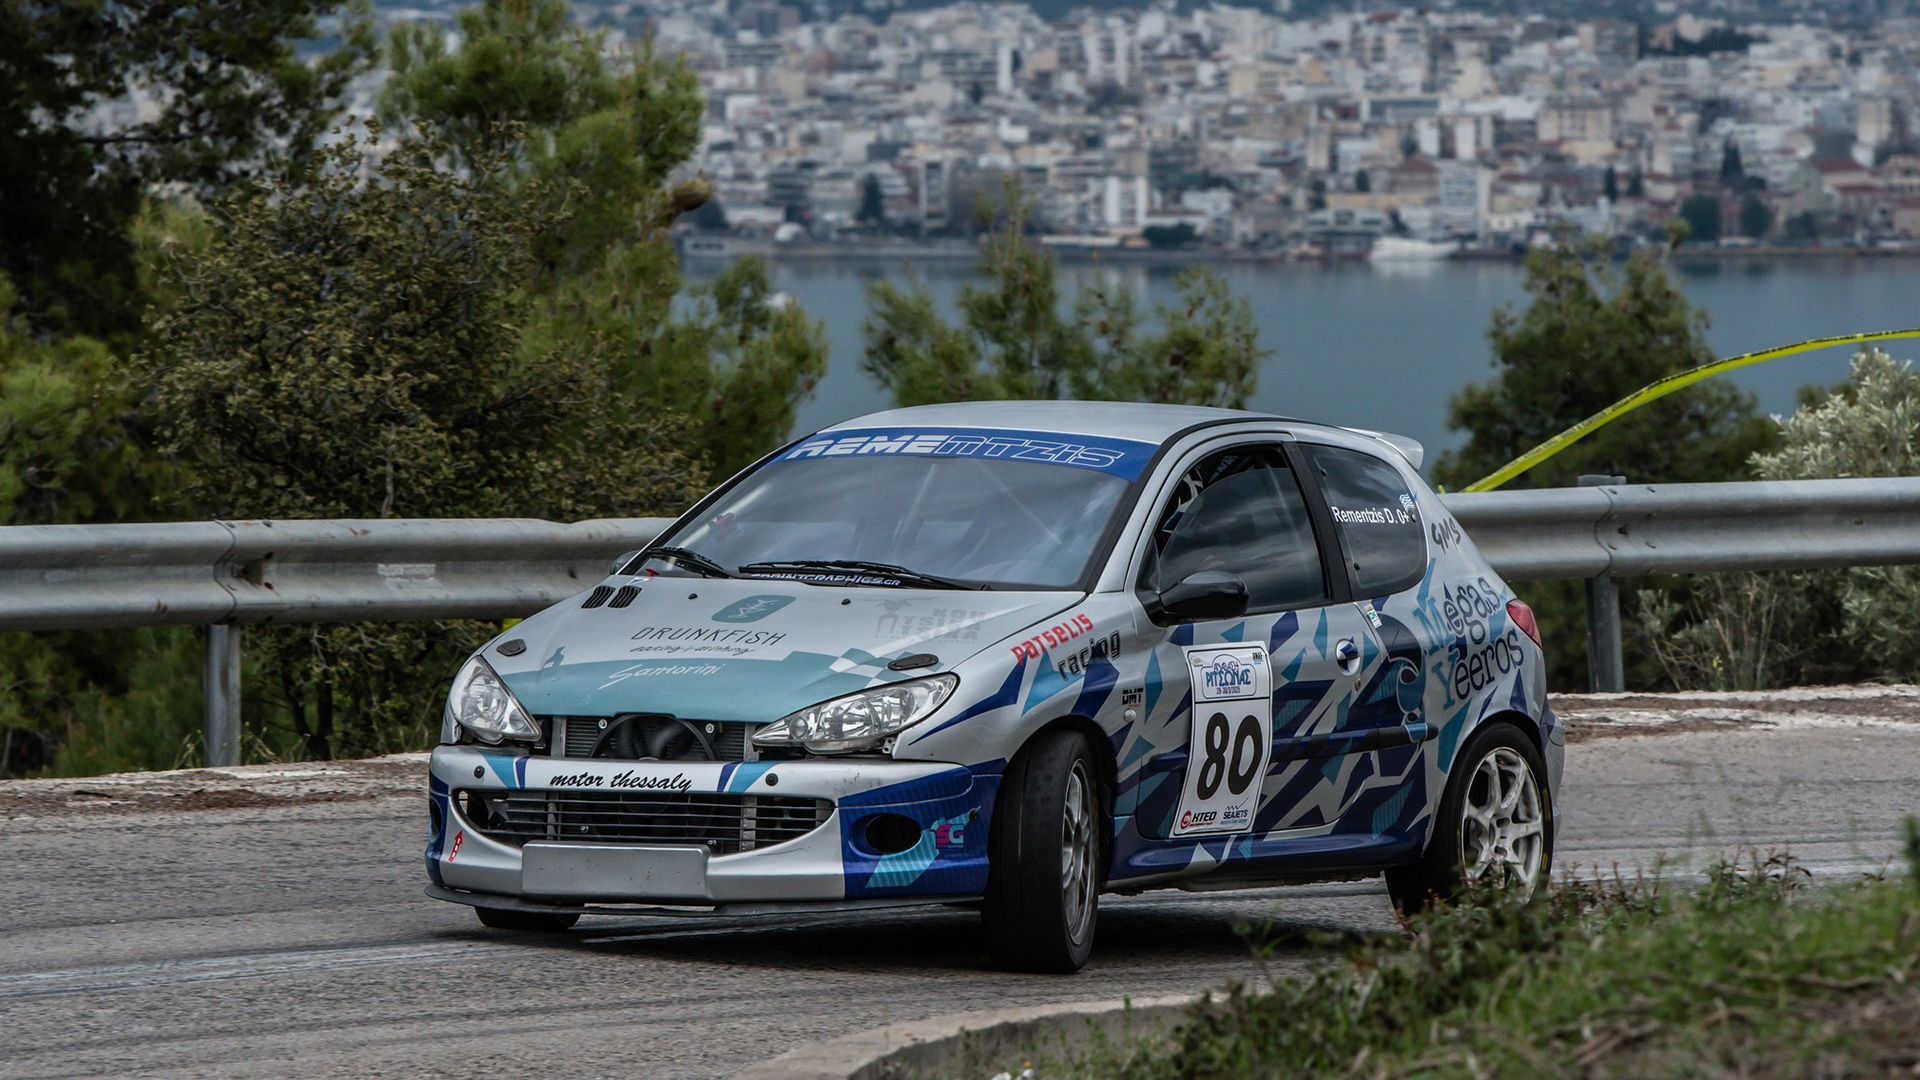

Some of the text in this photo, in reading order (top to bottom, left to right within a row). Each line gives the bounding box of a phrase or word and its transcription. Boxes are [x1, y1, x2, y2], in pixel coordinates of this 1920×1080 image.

[1331, 506, 1385, 523] Rementzis
[1383, 507, 1398, 524] D.
[1431, 517, 1461, 555] GMS
[1412, 576, 1501, 657] Megas
[630, 627, 777, 646] DRUNKFISH
[1057, 629, 1120, 682] racing
[1432, 628, 1524, 711] Yeeros
[598, 663, 727, 690] Santorini
[1197, 712, 1264, 800] 80
[550, 769, 692, 793] motor thessaly
[1222, 809, 1249, 820] SEAJETS
